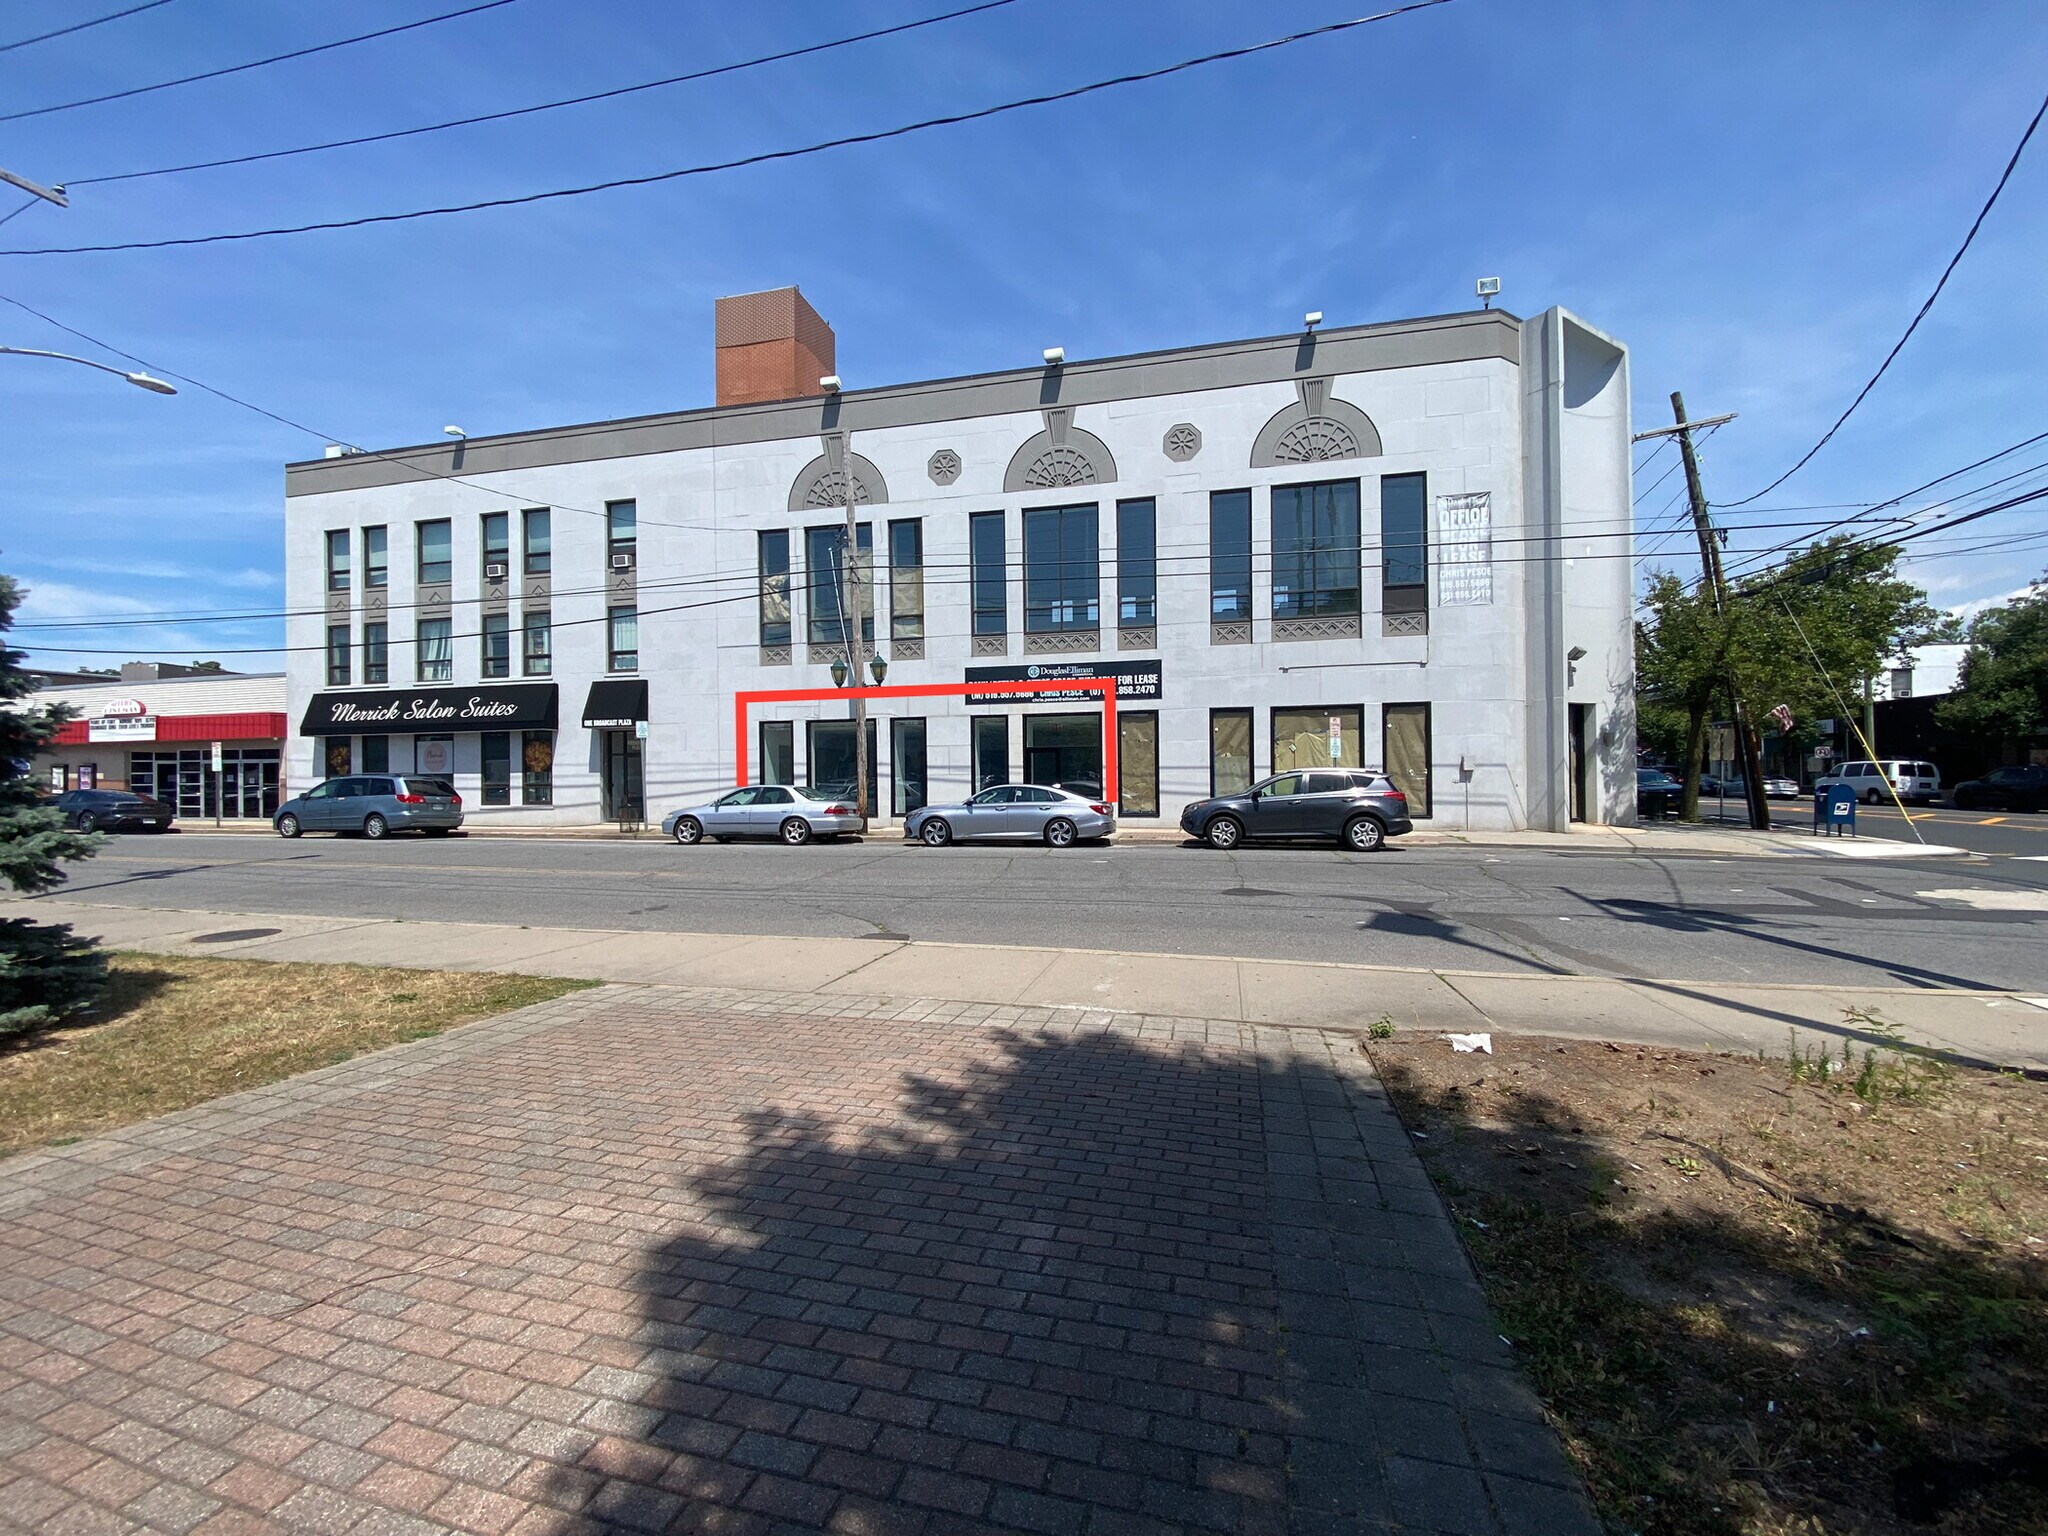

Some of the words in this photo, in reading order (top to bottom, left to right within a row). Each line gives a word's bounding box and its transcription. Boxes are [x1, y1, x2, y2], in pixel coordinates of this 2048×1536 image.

[1439, 507, 1489, 526] OFFICE
[1443, 550, 1486, 565] LEASE
[1440, 569, 1465, 578] CHRIS
[1118, 676, 1133, 685] FOR
[1134, 674, 1158, 684] LEASE
[331, 700, 400, 722] Merrick
[403, 699, 457, 720] Salon
[460, 696, 518, 718] Suites
[584, 719, 593, 727] ONE
[618, 718, 633, 726] PLAZA
